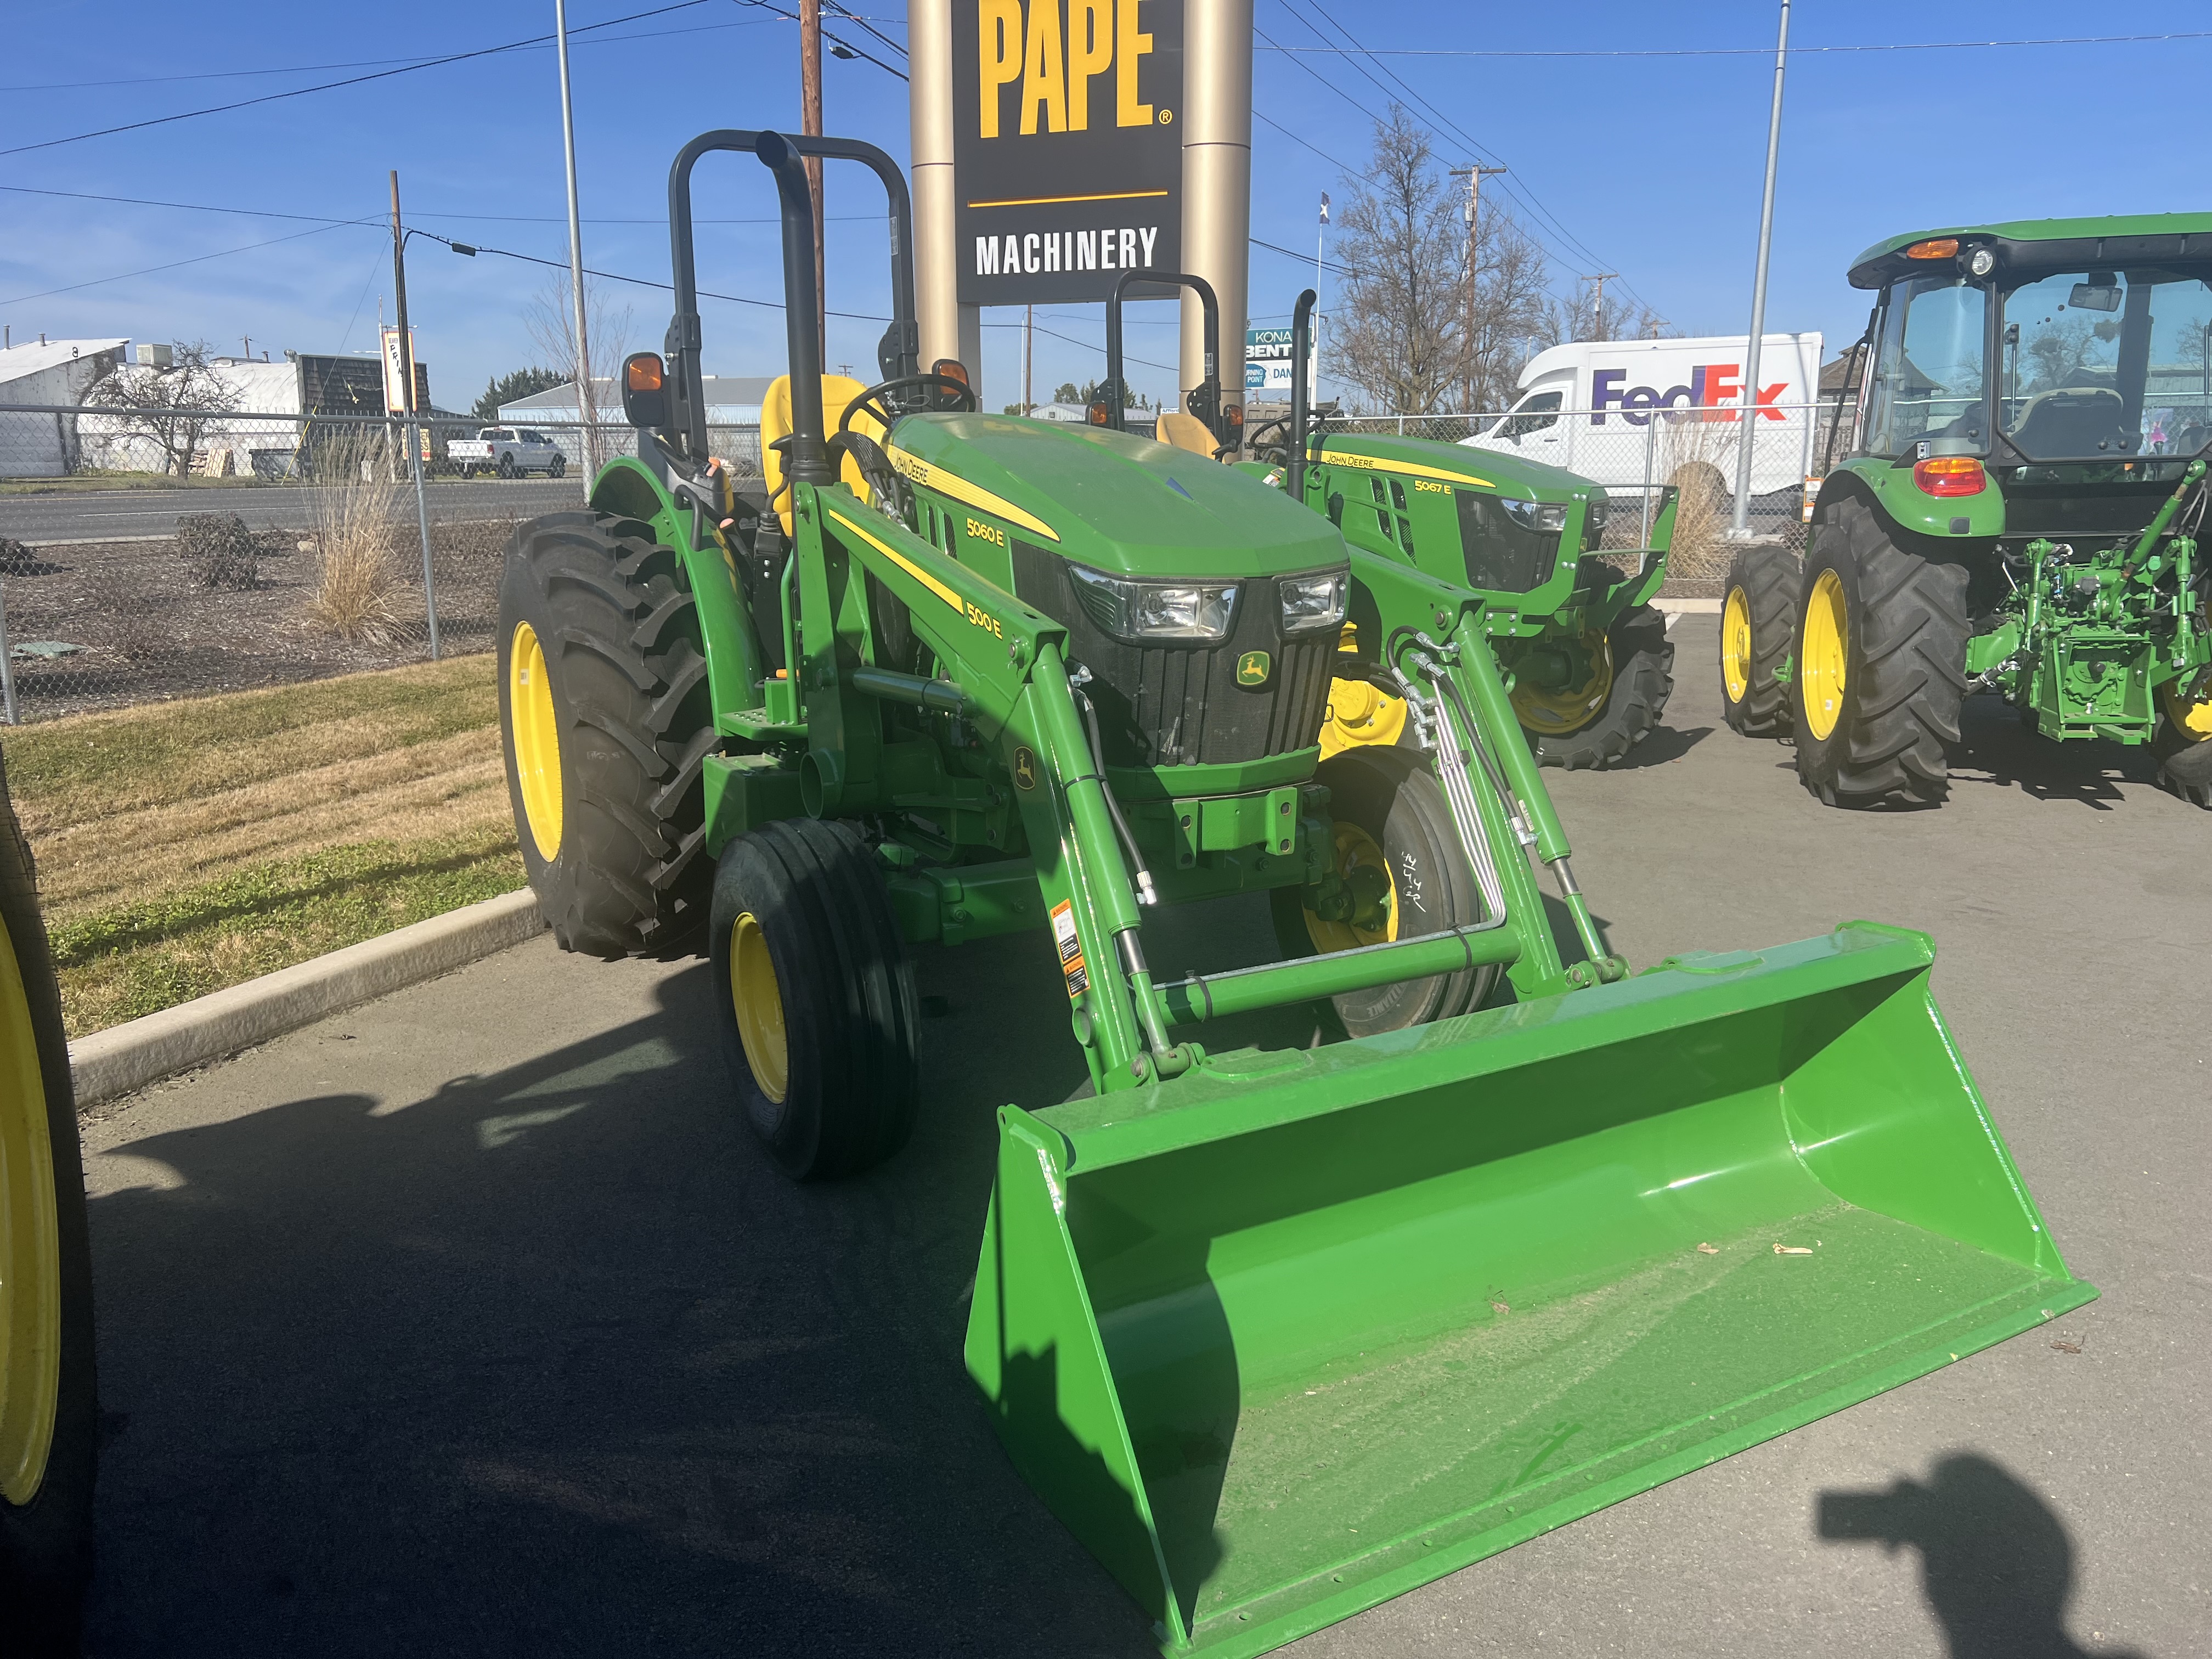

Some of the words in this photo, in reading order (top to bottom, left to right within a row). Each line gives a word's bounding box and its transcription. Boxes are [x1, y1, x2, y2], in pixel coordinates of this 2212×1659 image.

[976, 227, 1158, 275] MACHINERY
[1255, 331, 1293, 343] KONA
[1590, 364, 1790, 426] FedEx
[894, 453, 909, 474] JOHN
[908, 459, 928, 483] DEERE
[1327, 454, 1347, 465] JOHN
[1347, 456, 1374, 468] DEERE
[1414, 480, 1442, 493] 5067
[1443, 485, 1452, 495] E
[966, 517, 996, 543] 5060
[996, 529, 1005, 547] E
[966, 601, 993, 633] 500
[991, 618, 1003, 640] E
